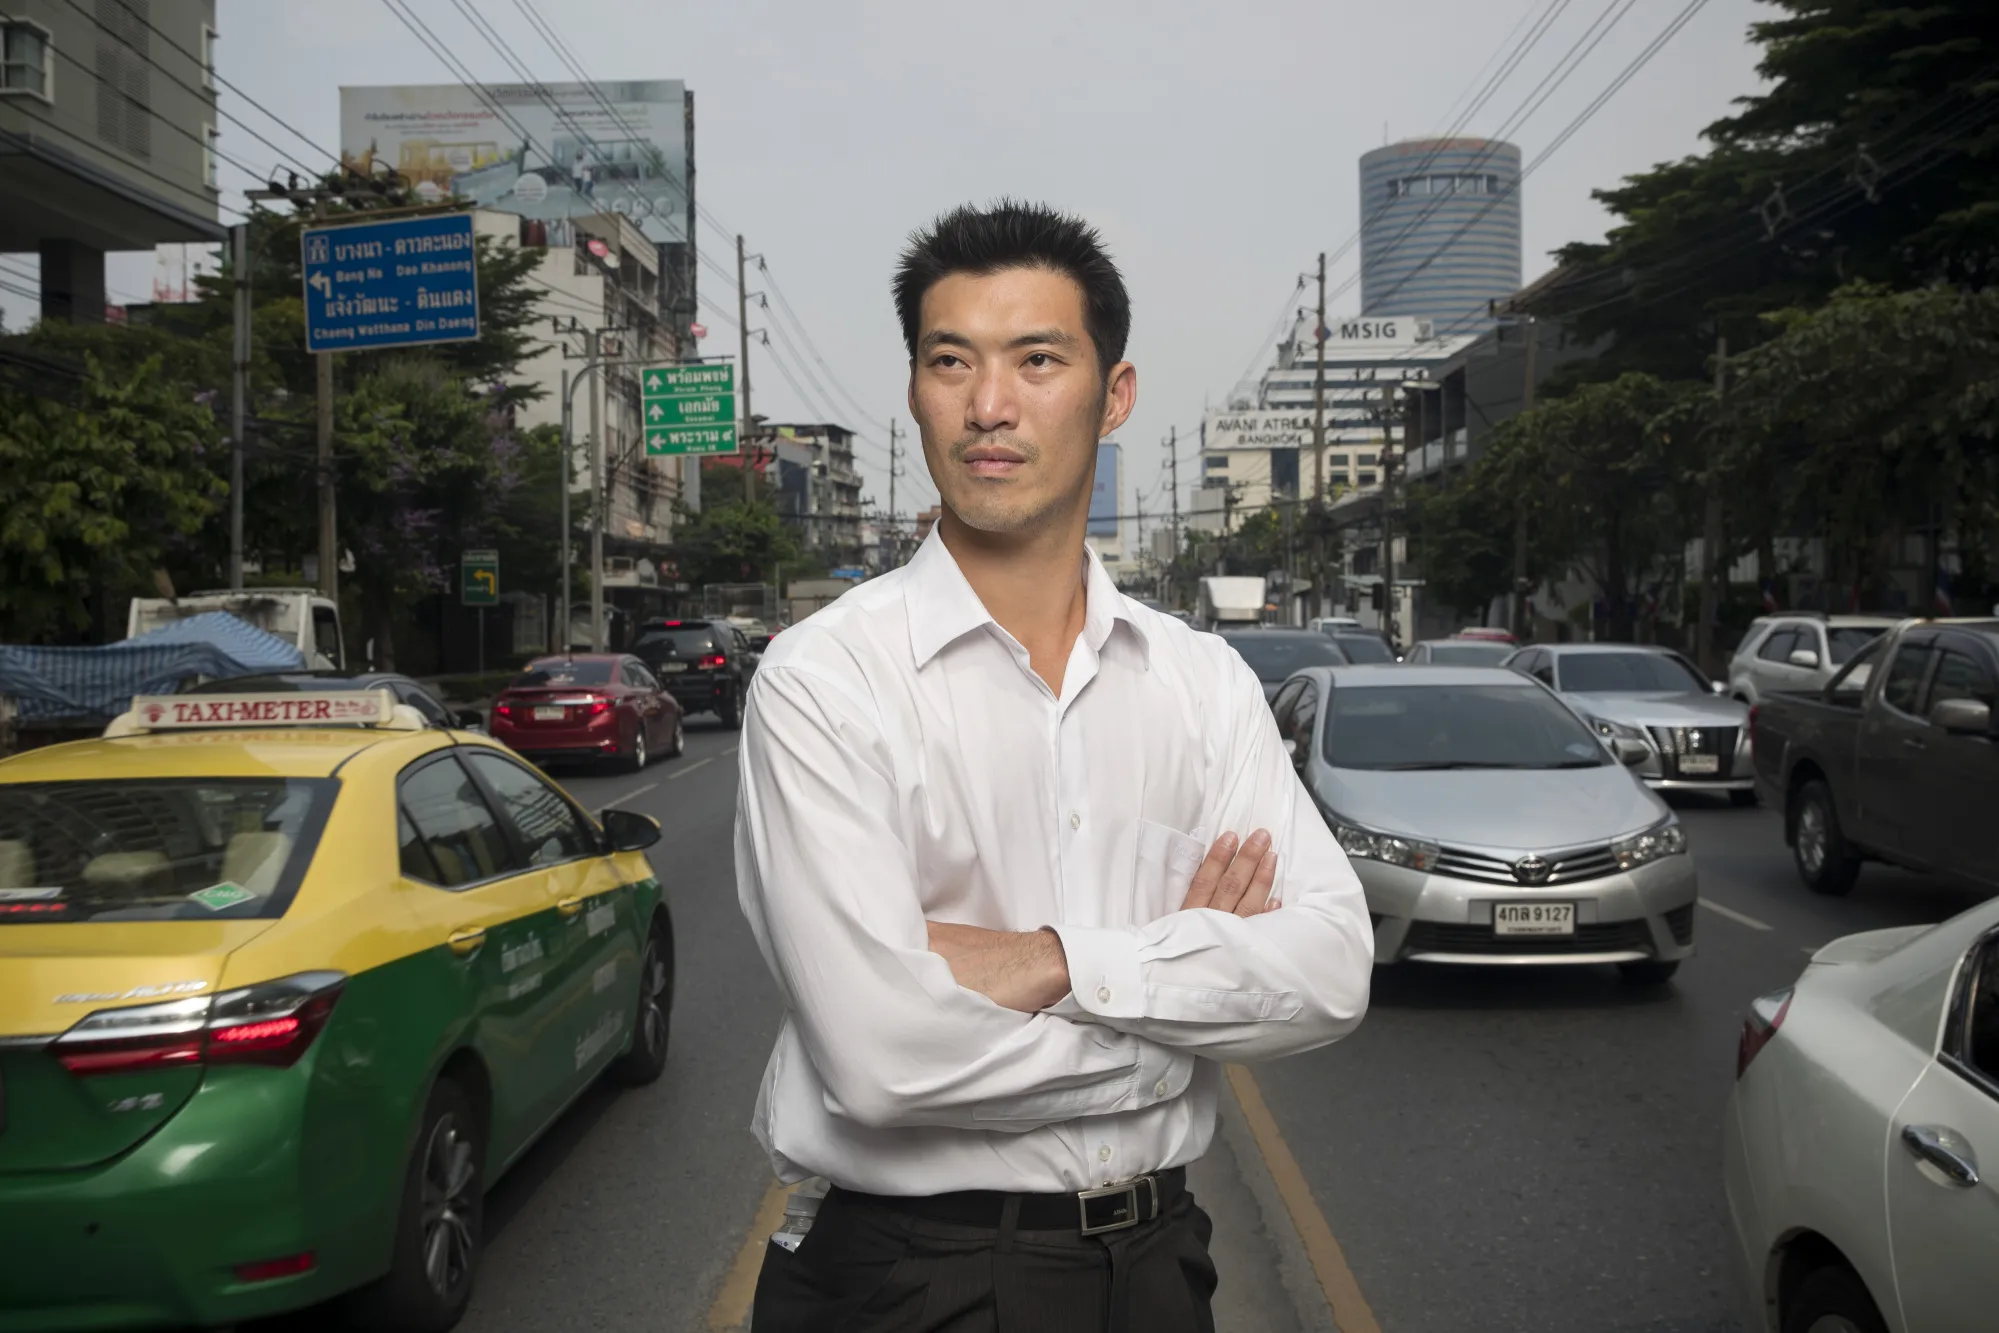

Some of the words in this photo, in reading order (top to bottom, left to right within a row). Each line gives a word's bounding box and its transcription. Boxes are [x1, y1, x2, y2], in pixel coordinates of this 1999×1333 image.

[335, 270, 365, 284] Bang
[366, 267, 383, 279] Na
[396, 264, 418, 277] Dao
[421, 260, 471, 274] Khanong
[415, 319, 436, 332] Din
[1341, 322, 1396, 339] MSIG
[1216, 419, 1257, 431] AVANI
[173, 699, 331, 723] TAXI-METER
[1534, 907, 1571, 922] 9127
